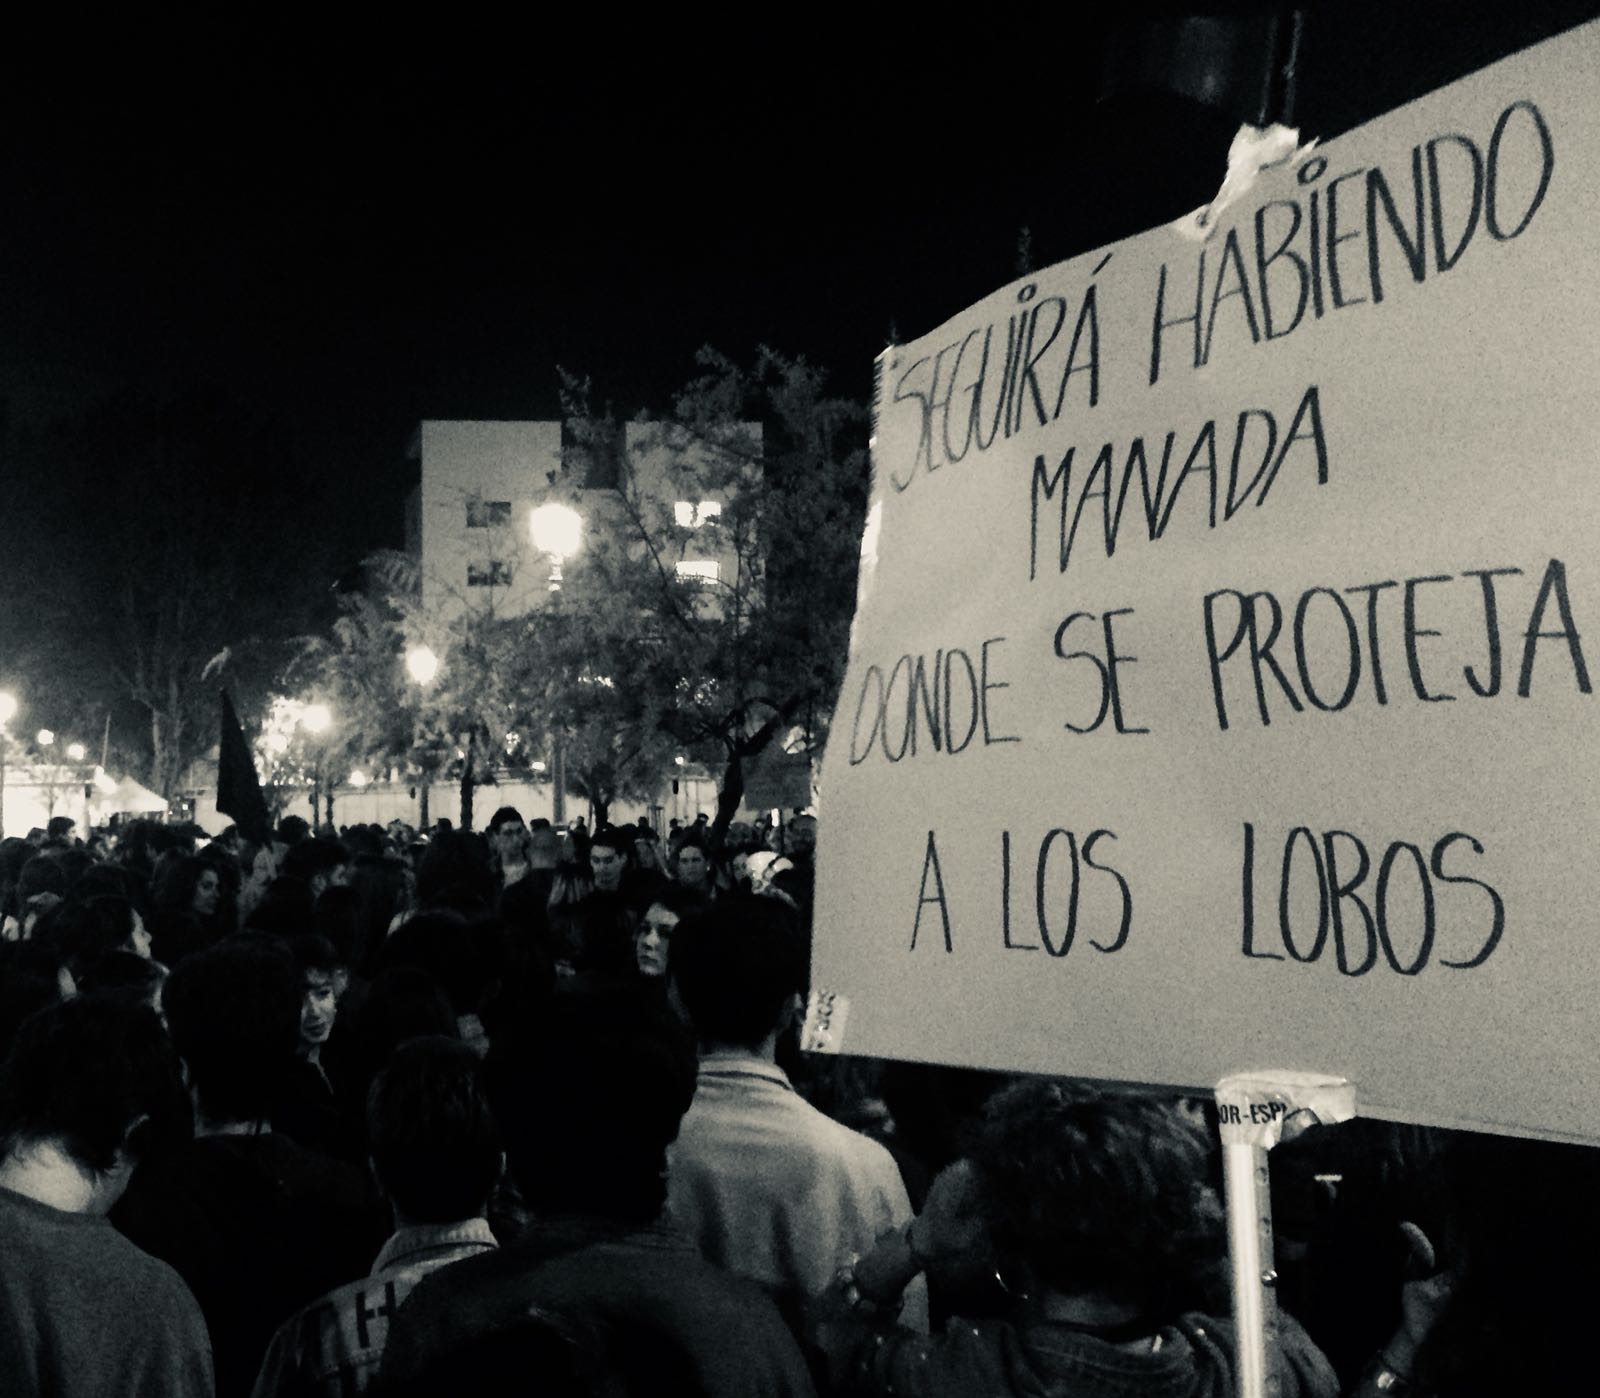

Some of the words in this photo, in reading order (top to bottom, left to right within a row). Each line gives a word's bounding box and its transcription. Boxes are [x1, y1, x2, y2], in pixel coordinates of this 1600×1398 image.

[1029, 384, 1329, 582] MANADA
[849, 637, 1022, 766] DONDE
[1053, 607, 1150, 735] SE
[1202, 557, 1593, 732] PROTEJA
[909, 829, 953, 954] A
[1001, 827, 1133, 958] LOS
[1241, 821, 1506, 978] LOBOS
